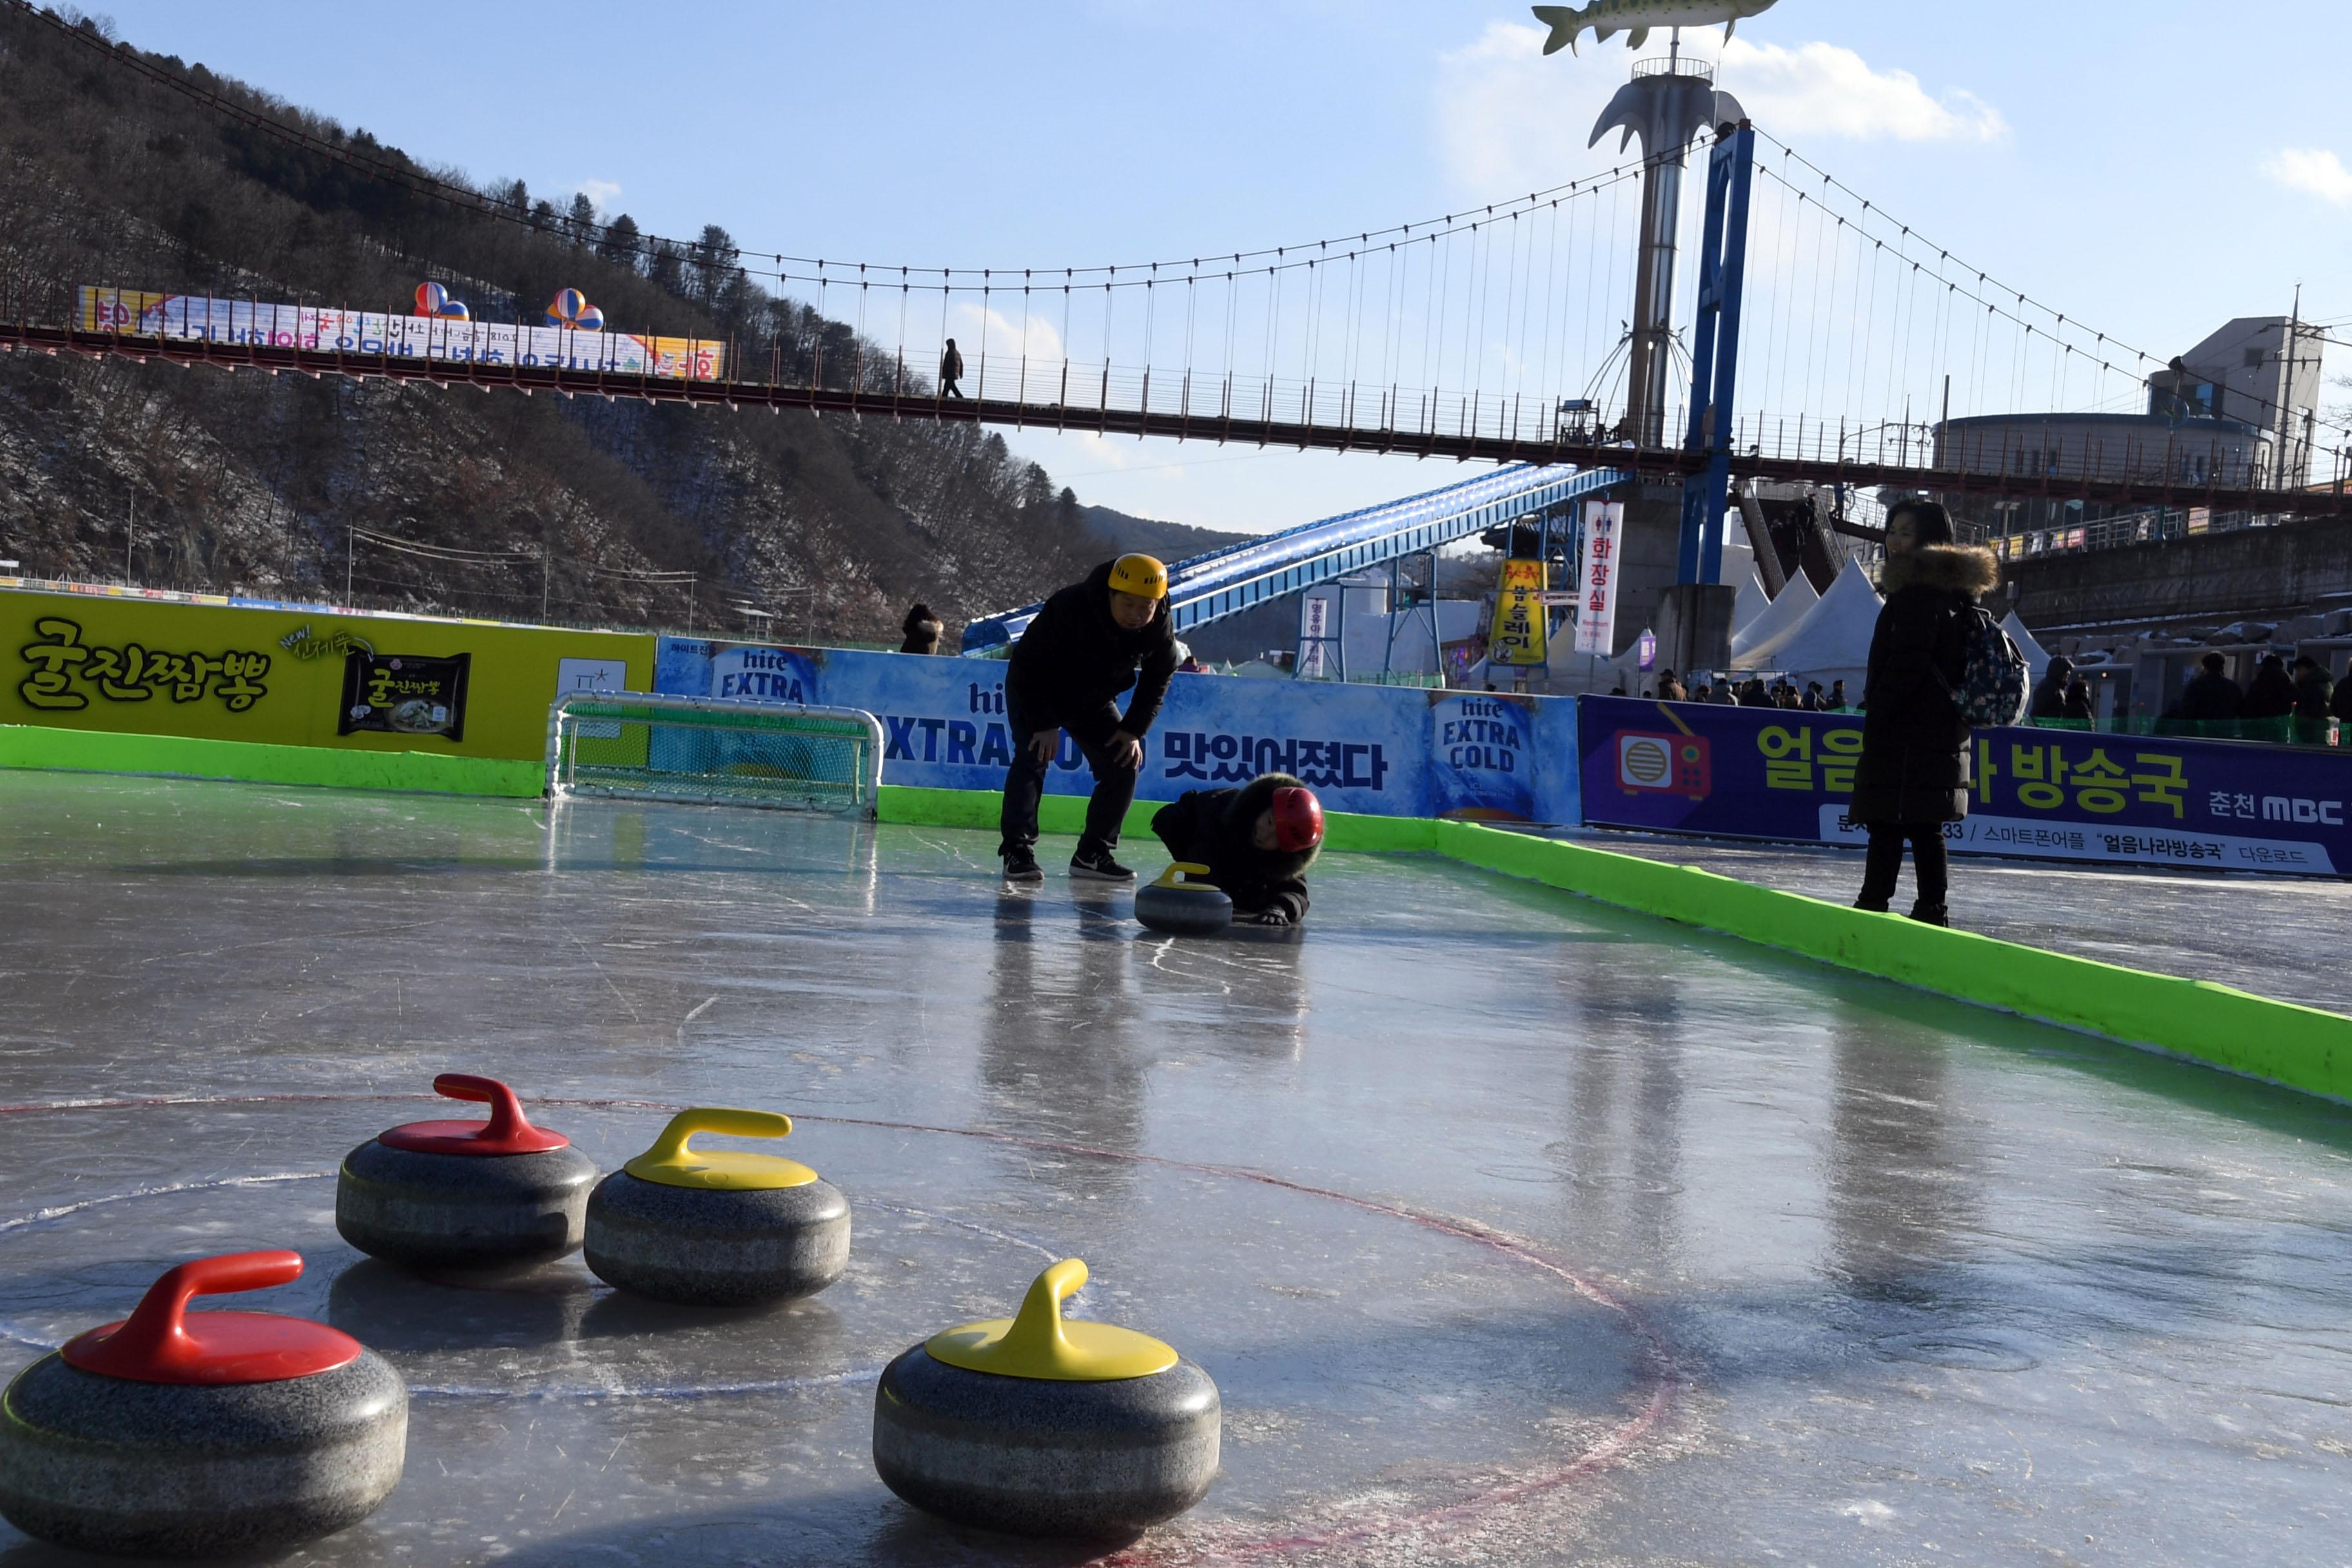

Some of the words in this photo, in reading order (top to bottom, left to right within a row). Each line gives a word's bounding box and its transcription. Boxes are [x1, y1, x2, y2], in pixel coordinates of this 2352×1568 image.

[1589, 537, 1613, 612] 화장실
[280, 625, 311, 650] New!
[293, 631, 355, 660] 신제품
[19, 616, 271, 712] 굴진짬뽕
[743, 649, 789, 672] hite
[368, 668, 441, 708] 굴진짬뽕
[721, 672, 804, 704] EXTRA
[1461, 696, 1504, 719] hite
[874, 714, 1012, 767] XTRA
[1443, 719, 1521, 750] EXTRA
[1164, 732, 1388, 791] 맛있어졌다
[1449, 744, 1515, 774] COLD
[2012, 744, 2189, 819] 방송국
[2209, 790, 2255, 820] 춘천
[2262, 796, 2344, 826] MBC
[1984, 826, 2085, 851] 스마트폰어플
[2239, 846, 2309, 865] 다운로드
